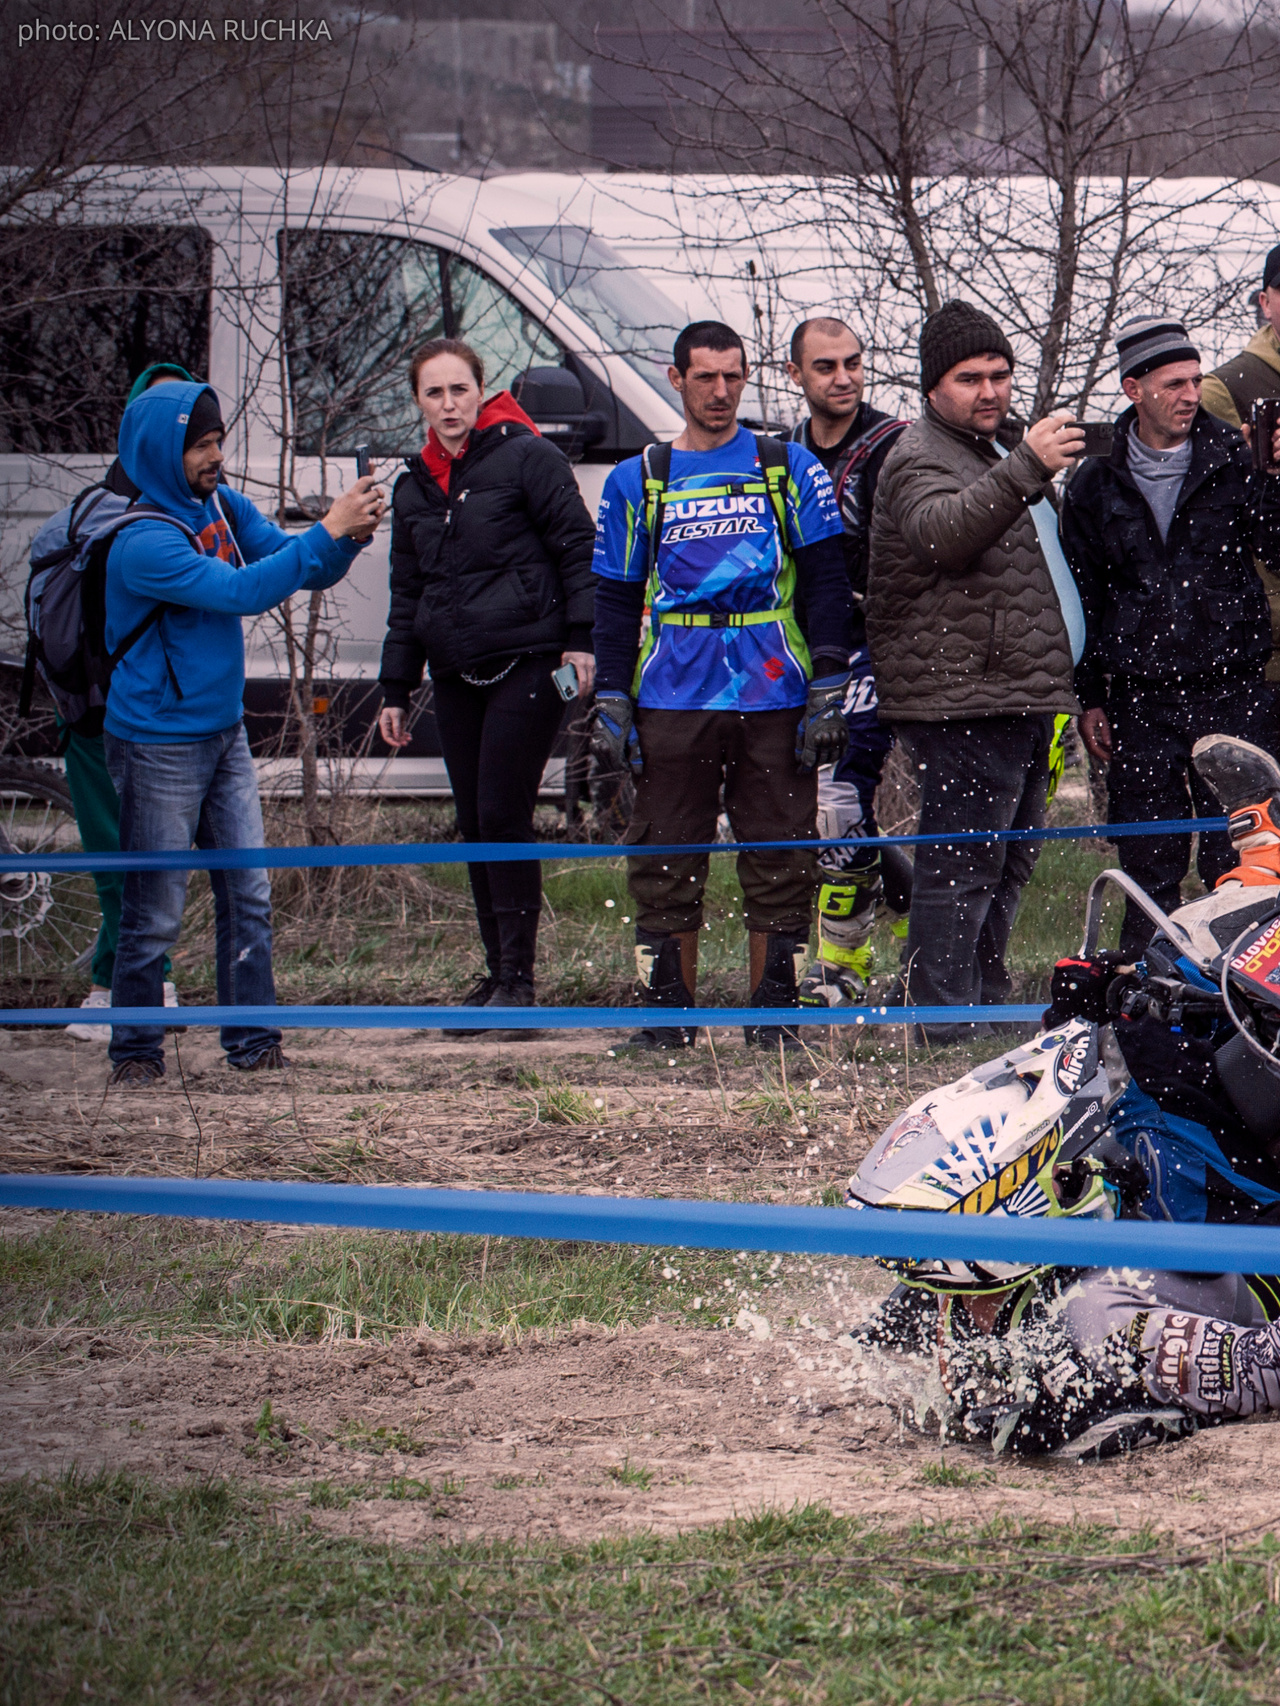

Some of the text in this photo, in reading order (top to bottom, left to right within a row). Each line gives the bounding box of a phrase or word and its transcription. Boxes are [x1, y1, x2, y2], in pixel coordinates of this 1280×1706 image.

[663, 496, 766, 523] SUZUKI
[661, 516, 768, 544] ECSTAR
[1058, 1036, 1091, 1091] Airoh
